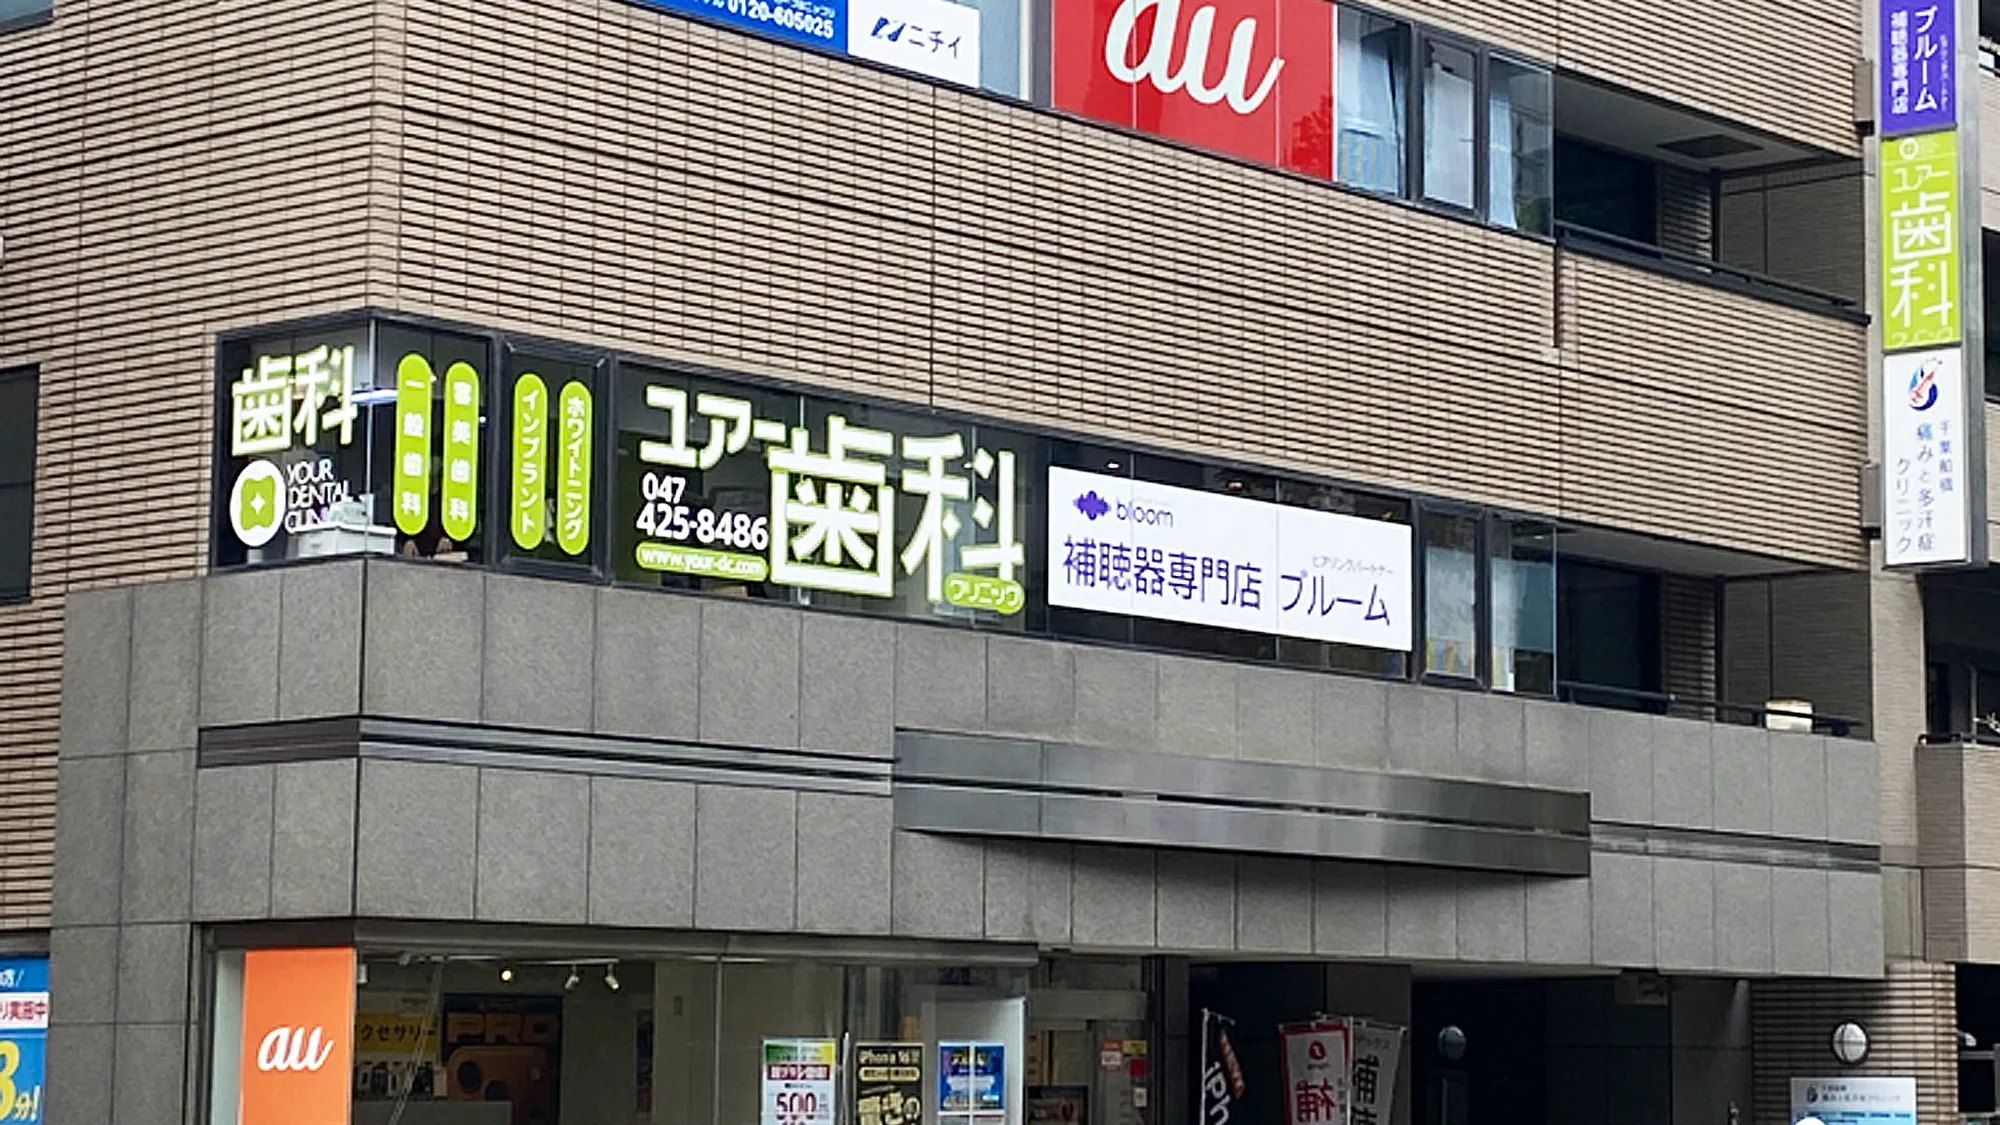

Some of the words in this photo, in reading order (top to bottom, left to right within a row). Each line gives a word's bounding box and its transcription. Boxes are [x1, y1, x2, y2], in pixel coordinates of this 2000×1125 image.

[908, 30, 961, 60] ニチイ
[1105, 0, 1285, 114] au
[1890, 191, 1953, 328] 歯科
[231, 344, 358, 458] 歯科
[286, 459, 334, 486] YOUR
[401, 380, 425, 517] 一般歯科
[449, 381, 472, 522] 審美歯科
[520, 389, 540, 534] インプラント
[565, 396, 585, 540] ホワイトニング
[288, 480, 354, 509] DENTAL
[636, 502, 769, 550] 425-8486
[642, 472, 686, 504] 047
[767, 415, 1025, 602] 歯科
[1116, 500, 1174, 527] bloom
[1897, 458, 1912, 553] クリニック
[951, 580, 1020, 607] クリニック
[1063, 534, 1263, 611] 補聴器専門店
[257, 1027, 334, 1072] au
[356, 1021, 437, 1042] クセサリー
